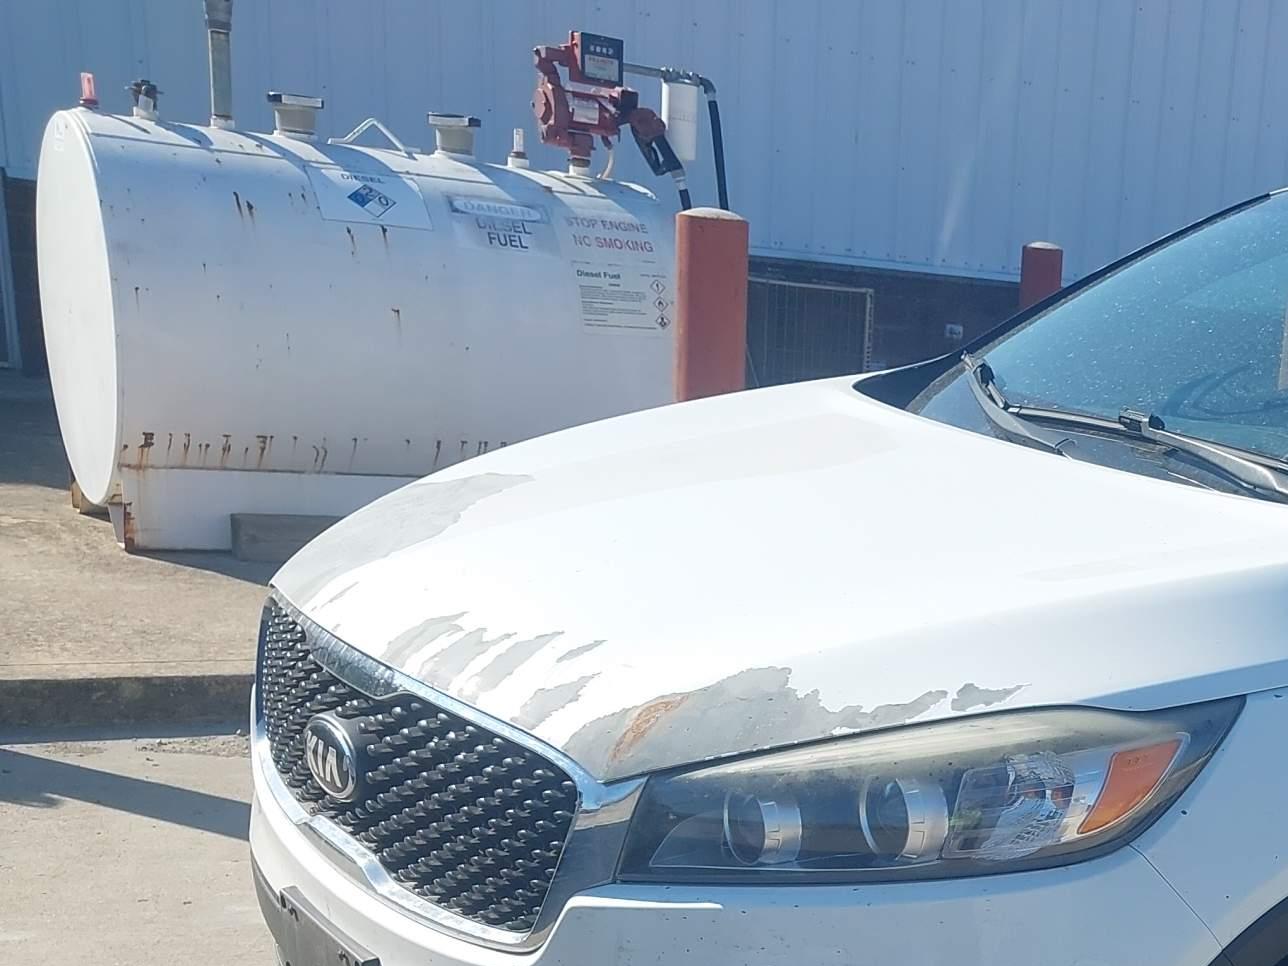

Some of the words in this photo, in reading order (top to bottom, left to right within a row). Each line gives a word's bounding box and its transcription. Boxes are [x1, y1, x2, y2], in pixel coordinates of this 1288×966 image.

[341, 173, 385, 184] DIESEL
[363, 186, 375, 199] 2
[378, 196, 390, 208] 0
[476, 217, 533, 235] DIESEL
[566, 216, 598, 229] STOP
[600, 219, 649, 234] ENGINE
[487, 231, 529, 249] FUEL
[594, 236, 654, 253] SMOKING
[576, 269, 602, 279] Diesel
[603, 272, 621, 280] Fuel
[306, 729, 343, 789] KIA
